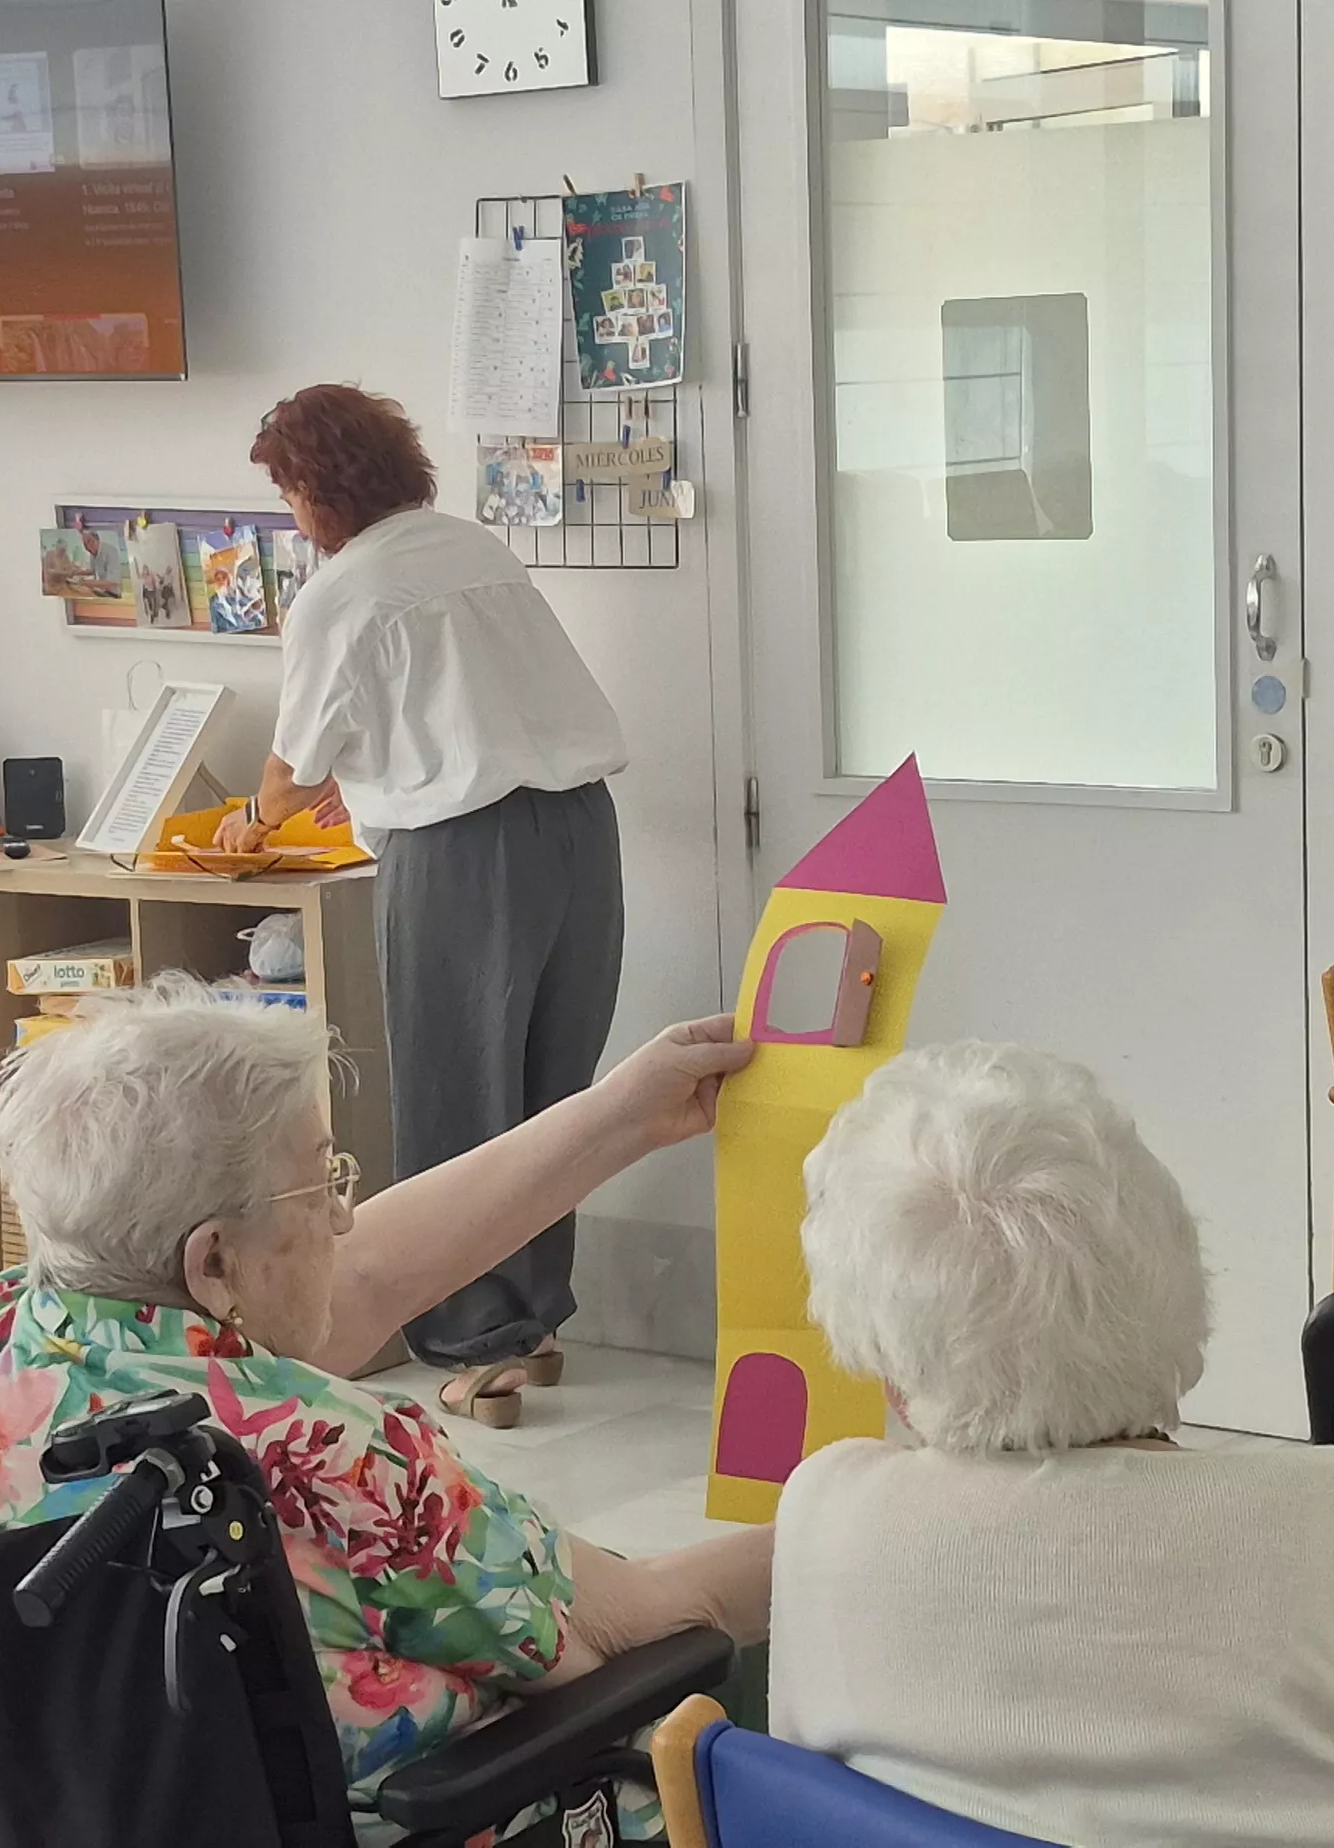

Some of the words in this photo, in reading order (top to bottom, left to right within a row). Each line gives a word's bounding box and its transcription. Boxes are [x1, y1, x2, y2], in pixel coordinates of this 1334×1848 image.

[474, 52, 490, 75] 7
[504, 60, 519, 82] 6
[575, 446, 665, 469] MIÉRCOLES
[53, 964, 85, 979] lotto
